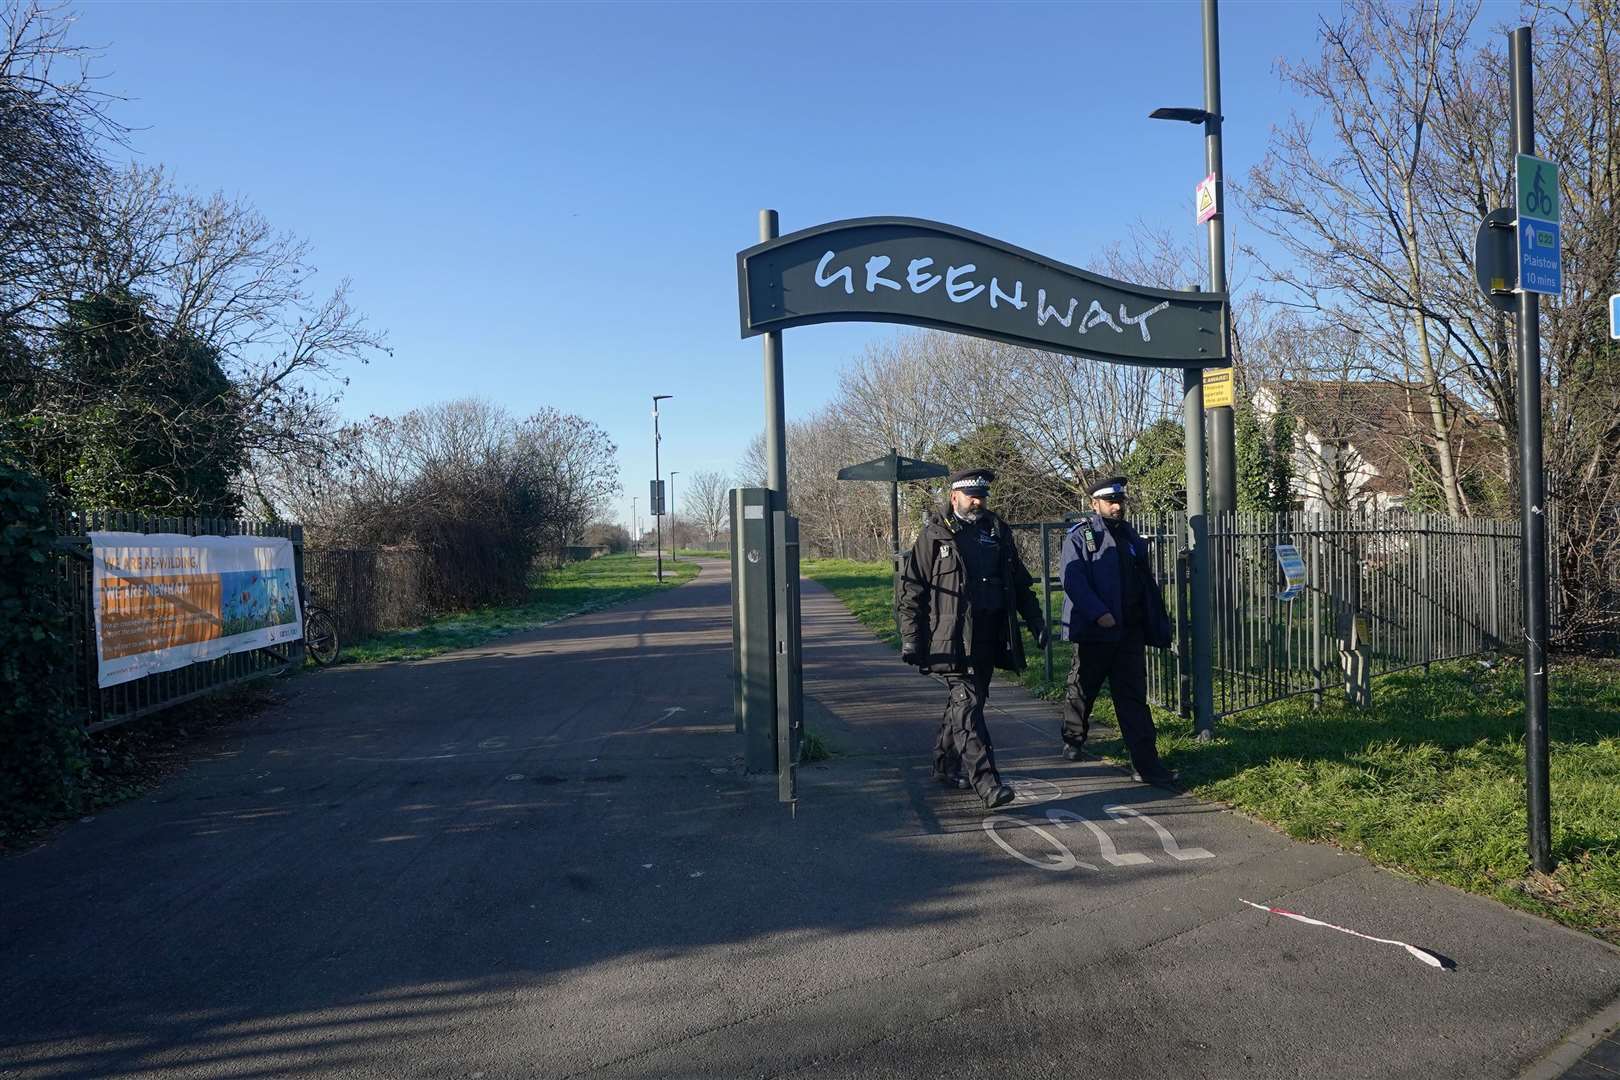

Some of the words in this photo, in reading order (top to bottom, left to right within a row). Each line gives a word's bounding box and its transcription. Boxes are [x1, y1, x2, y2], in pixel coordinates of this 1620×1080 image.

[1538, 233, 1553, 244] Q22
[1523, 253, 1558, 270] Plaistow
[1526, 272, 1536, 284] 10
[1537, 275, 1556, 287] mins
[814, 250, 1170, 343] GREENWAY
[104, 557, 120, 570] WE
[124, 557, 142, 570] ARE
[104, 586, 120, 600] WE
[124, 584, 144, 598] ARE
[983, 804, 1216, 871] Q22
